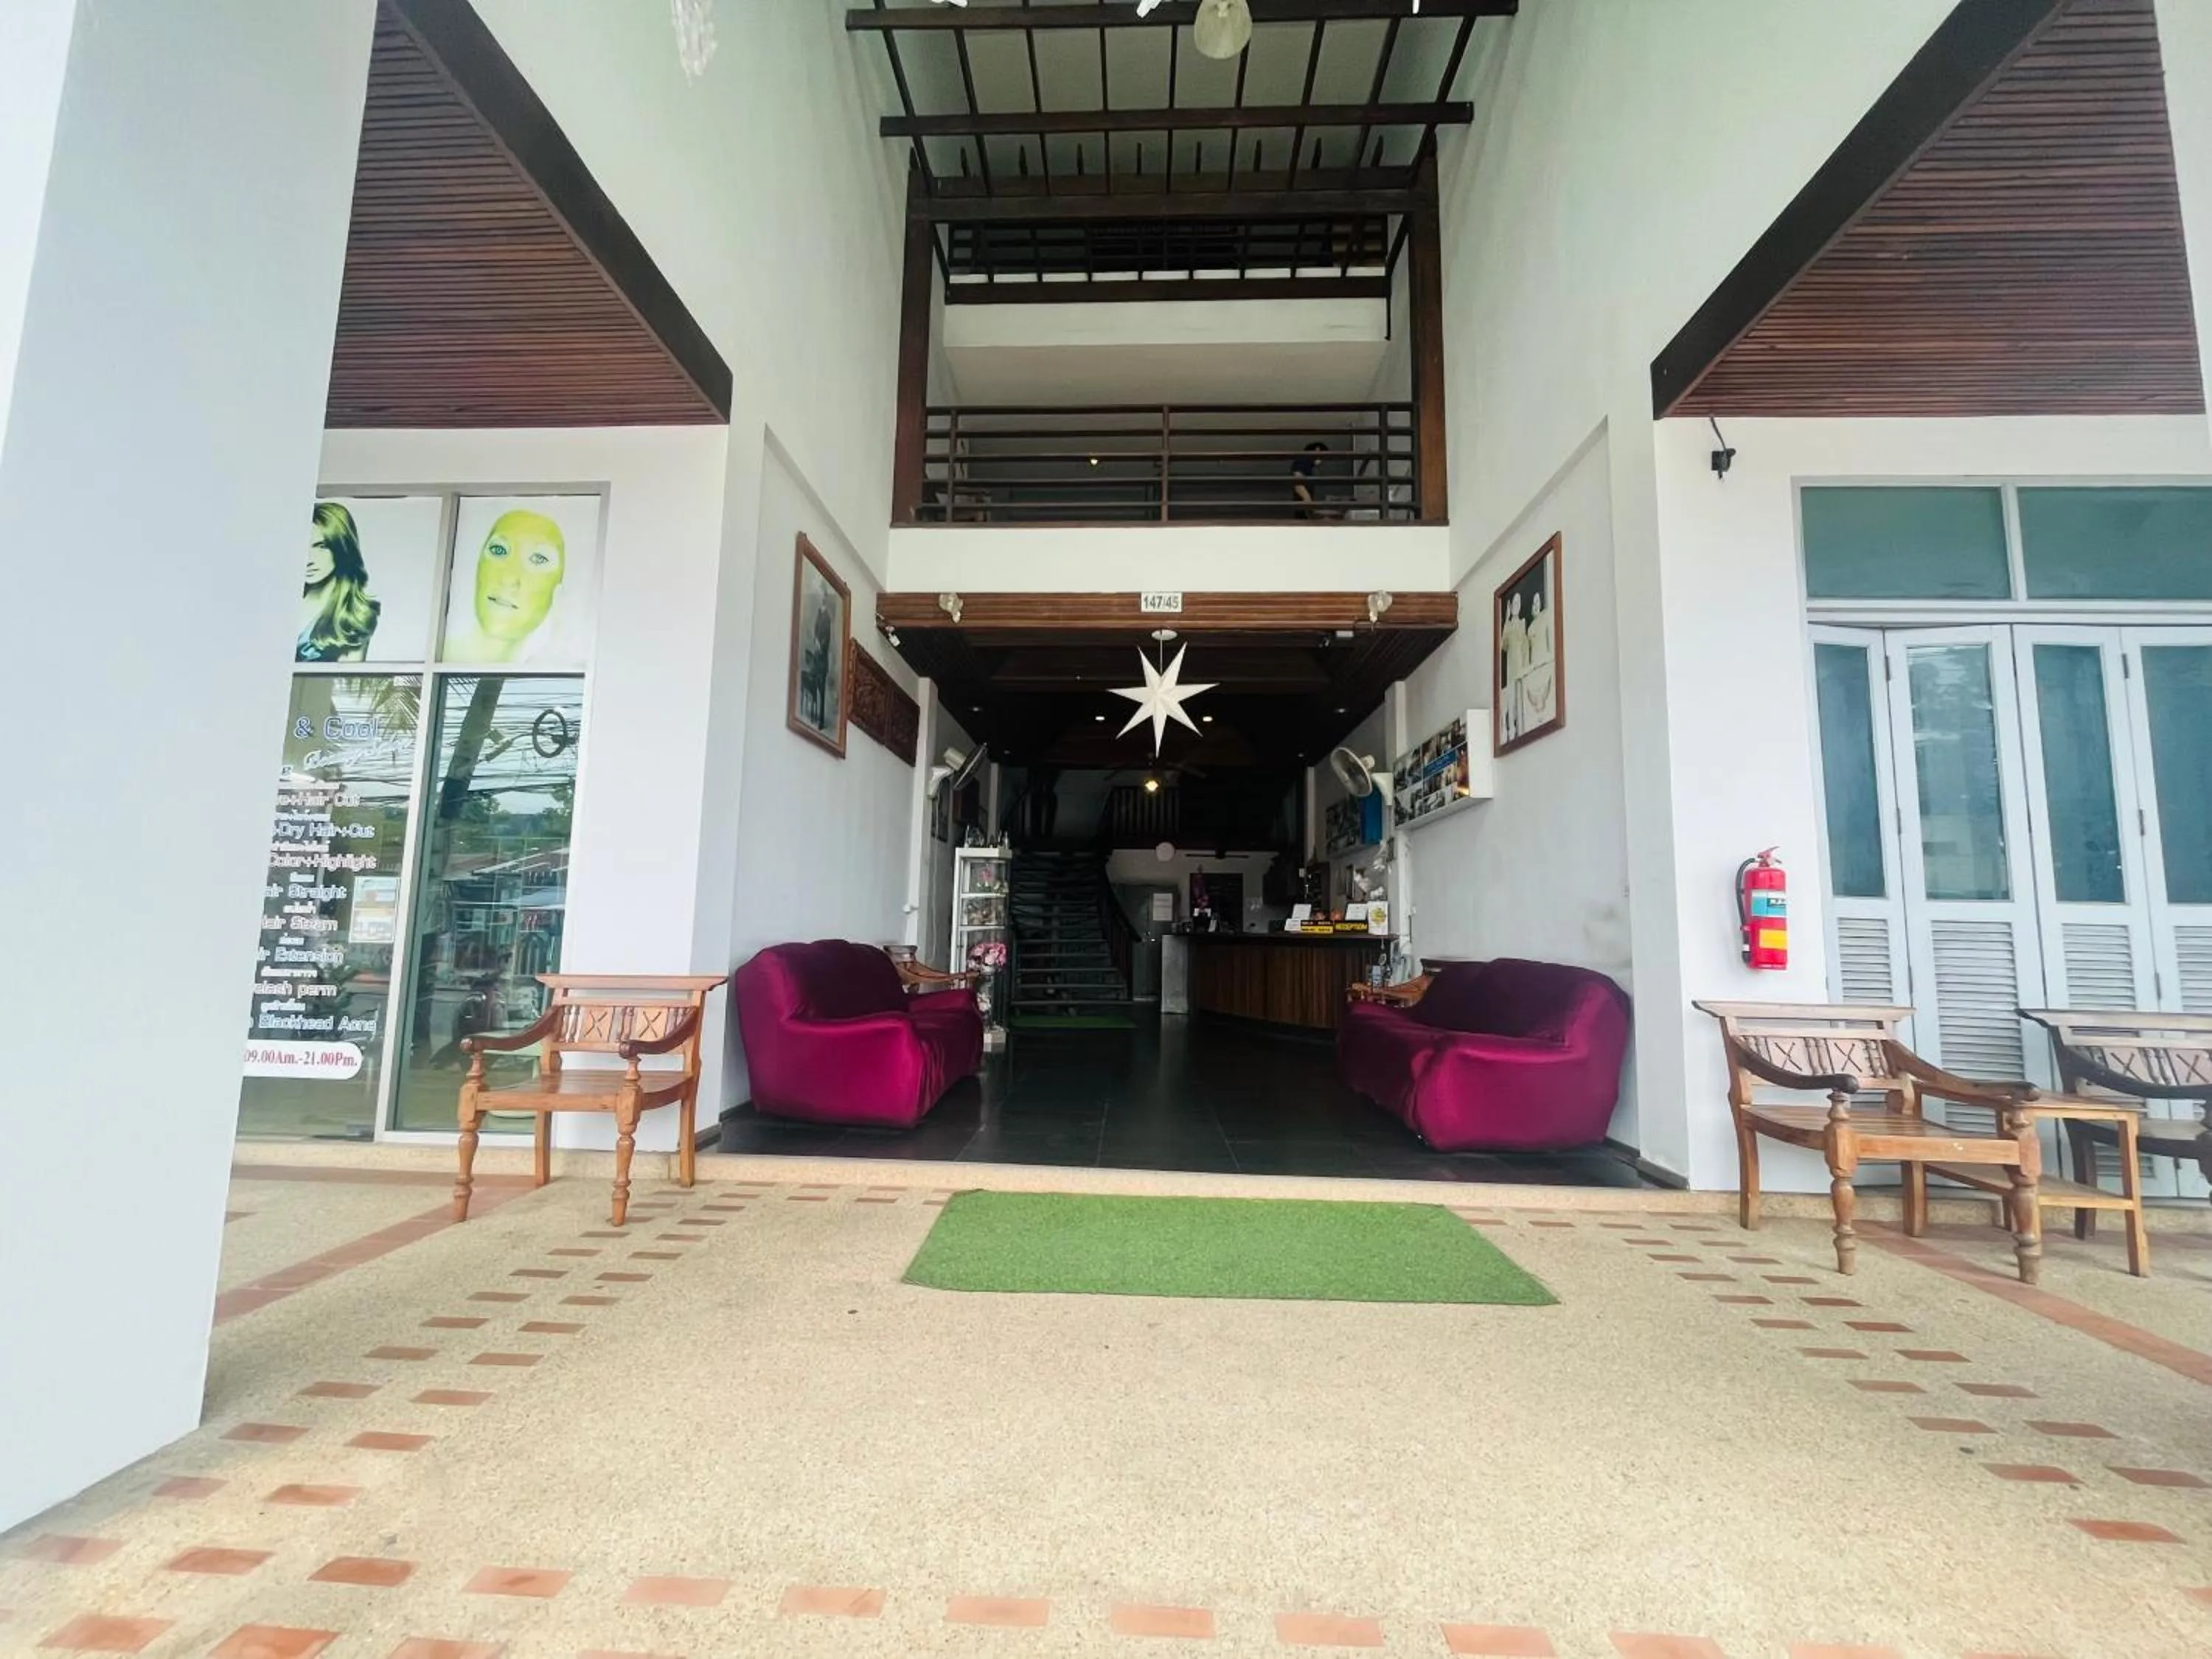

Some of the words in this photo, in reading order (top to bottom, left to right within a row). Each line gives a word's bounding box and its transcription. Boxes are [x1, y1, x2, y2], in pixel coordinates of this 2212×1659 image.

[1144, 595, 1180, 609] 147/45
[334, 792, 361, 807] Cut
[288, 883, 347, 902] Straight
[291, 915, 339, 931] Steam
[274, 946, 344, 965] Extension
[297, 984, 337, 998] perm
[259, 1013, 334, 1031] Blackhead
